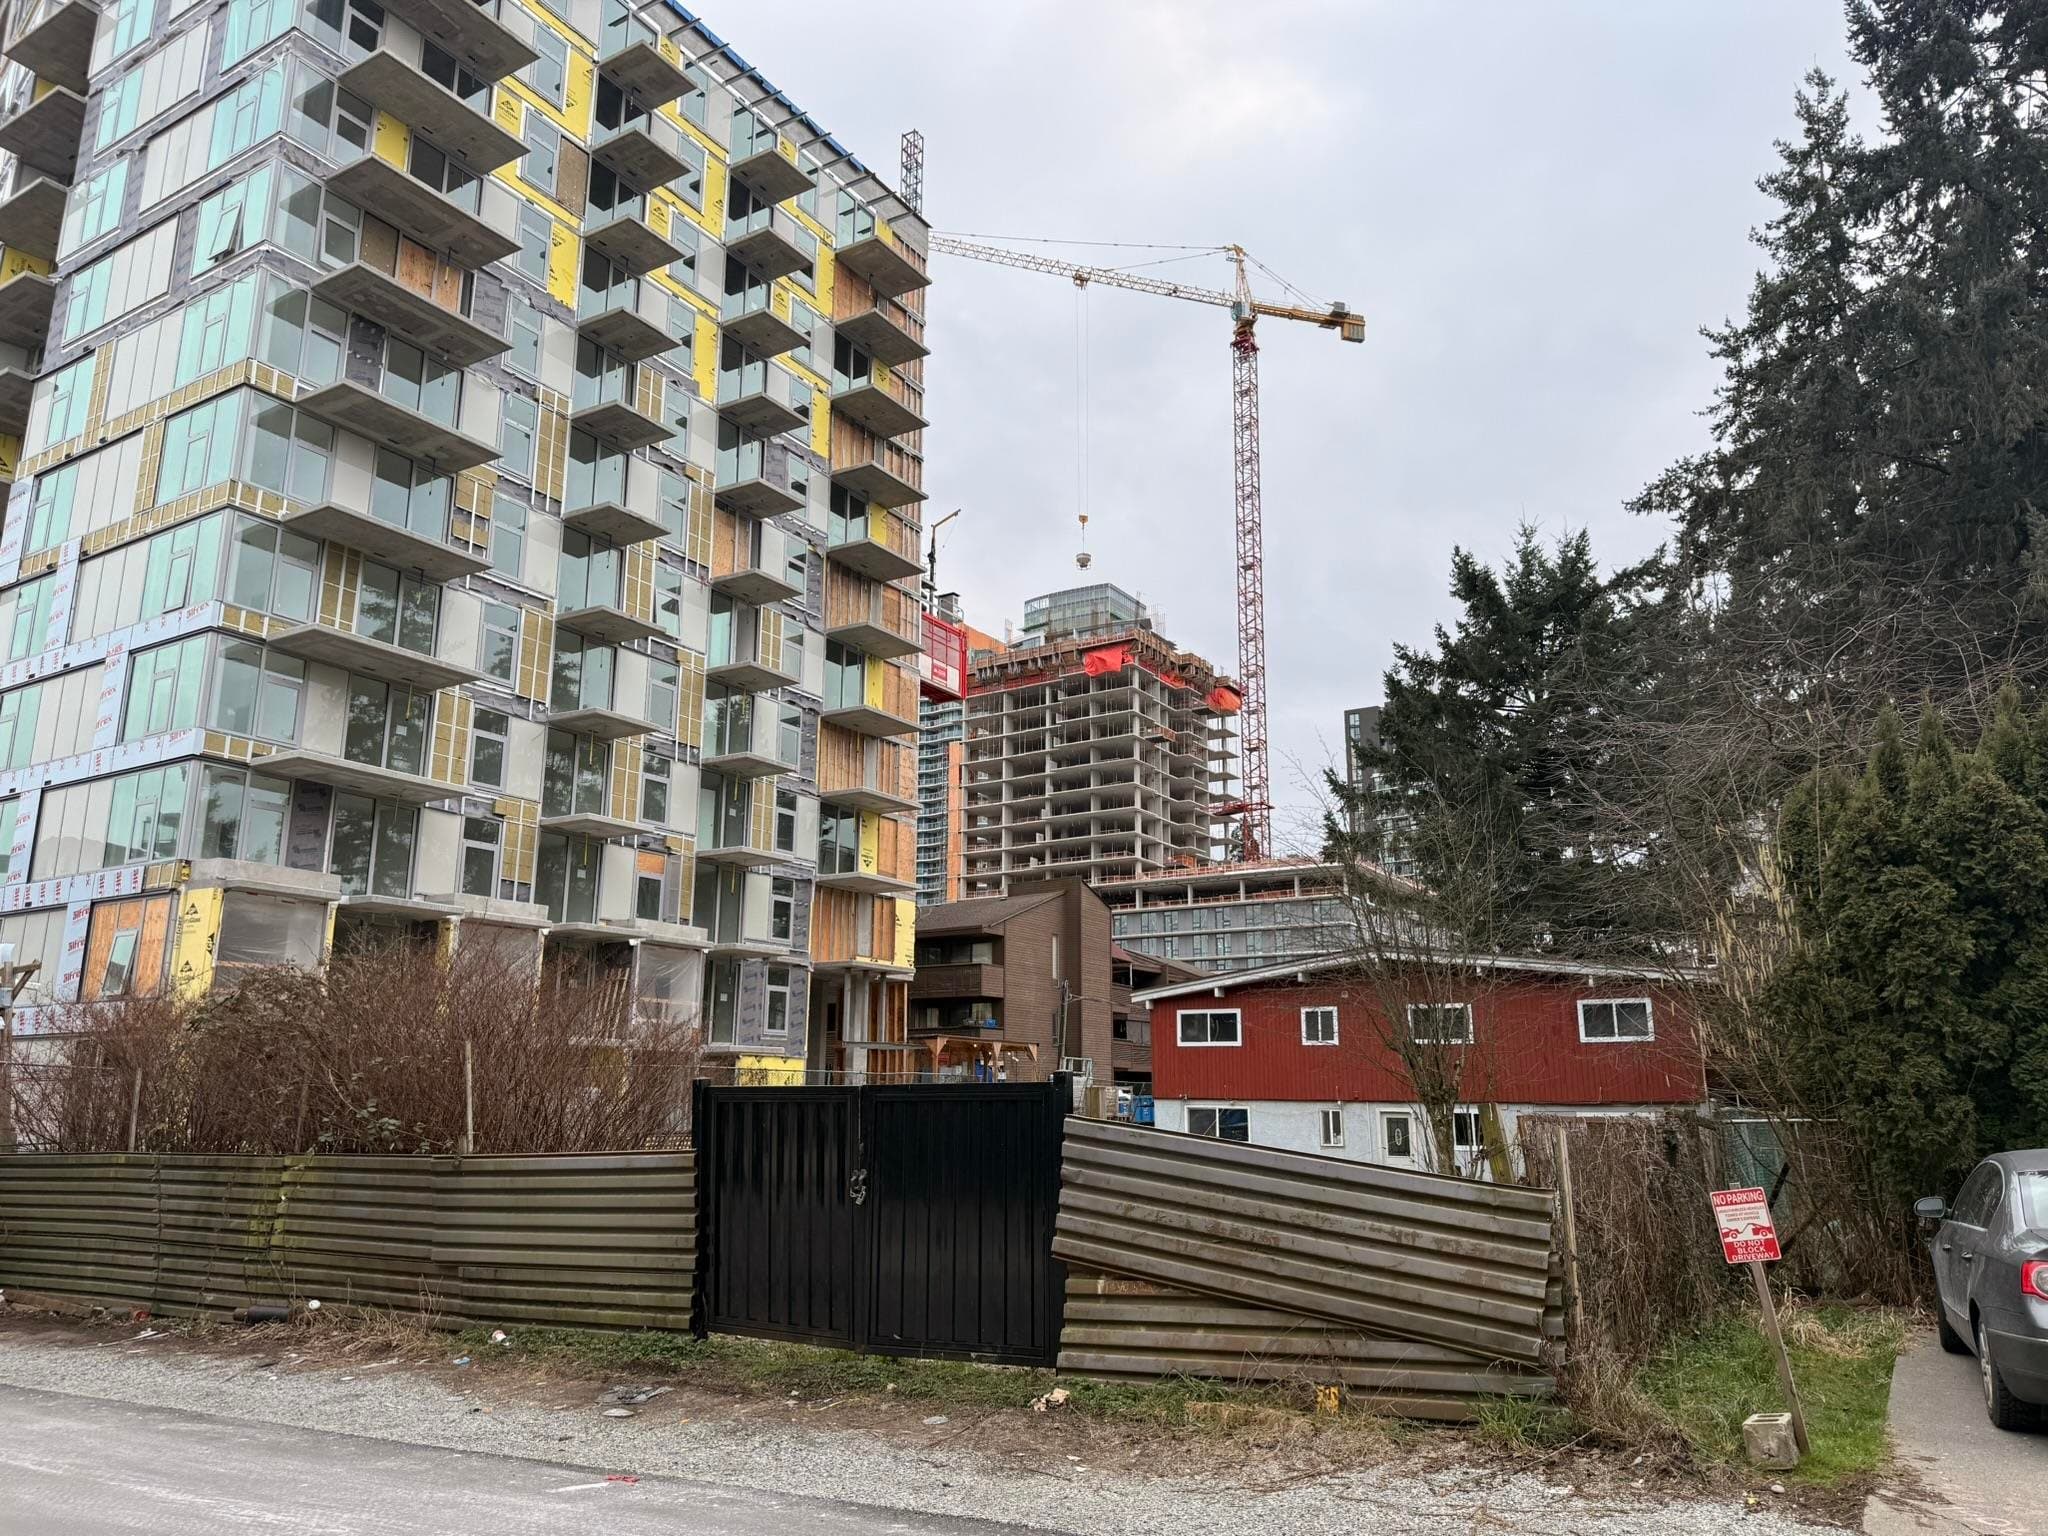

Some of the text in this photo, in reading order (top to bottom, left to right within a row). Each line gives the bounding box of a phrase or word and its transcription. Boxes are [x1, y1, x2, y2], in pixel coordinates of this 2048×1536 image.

[1713, 1190, 1763, 1205] NO PARKING
[1737, 1246, 1766, 1254] BLOCK
[1732, 1251, 1775, 1261] DRIVEWAY
